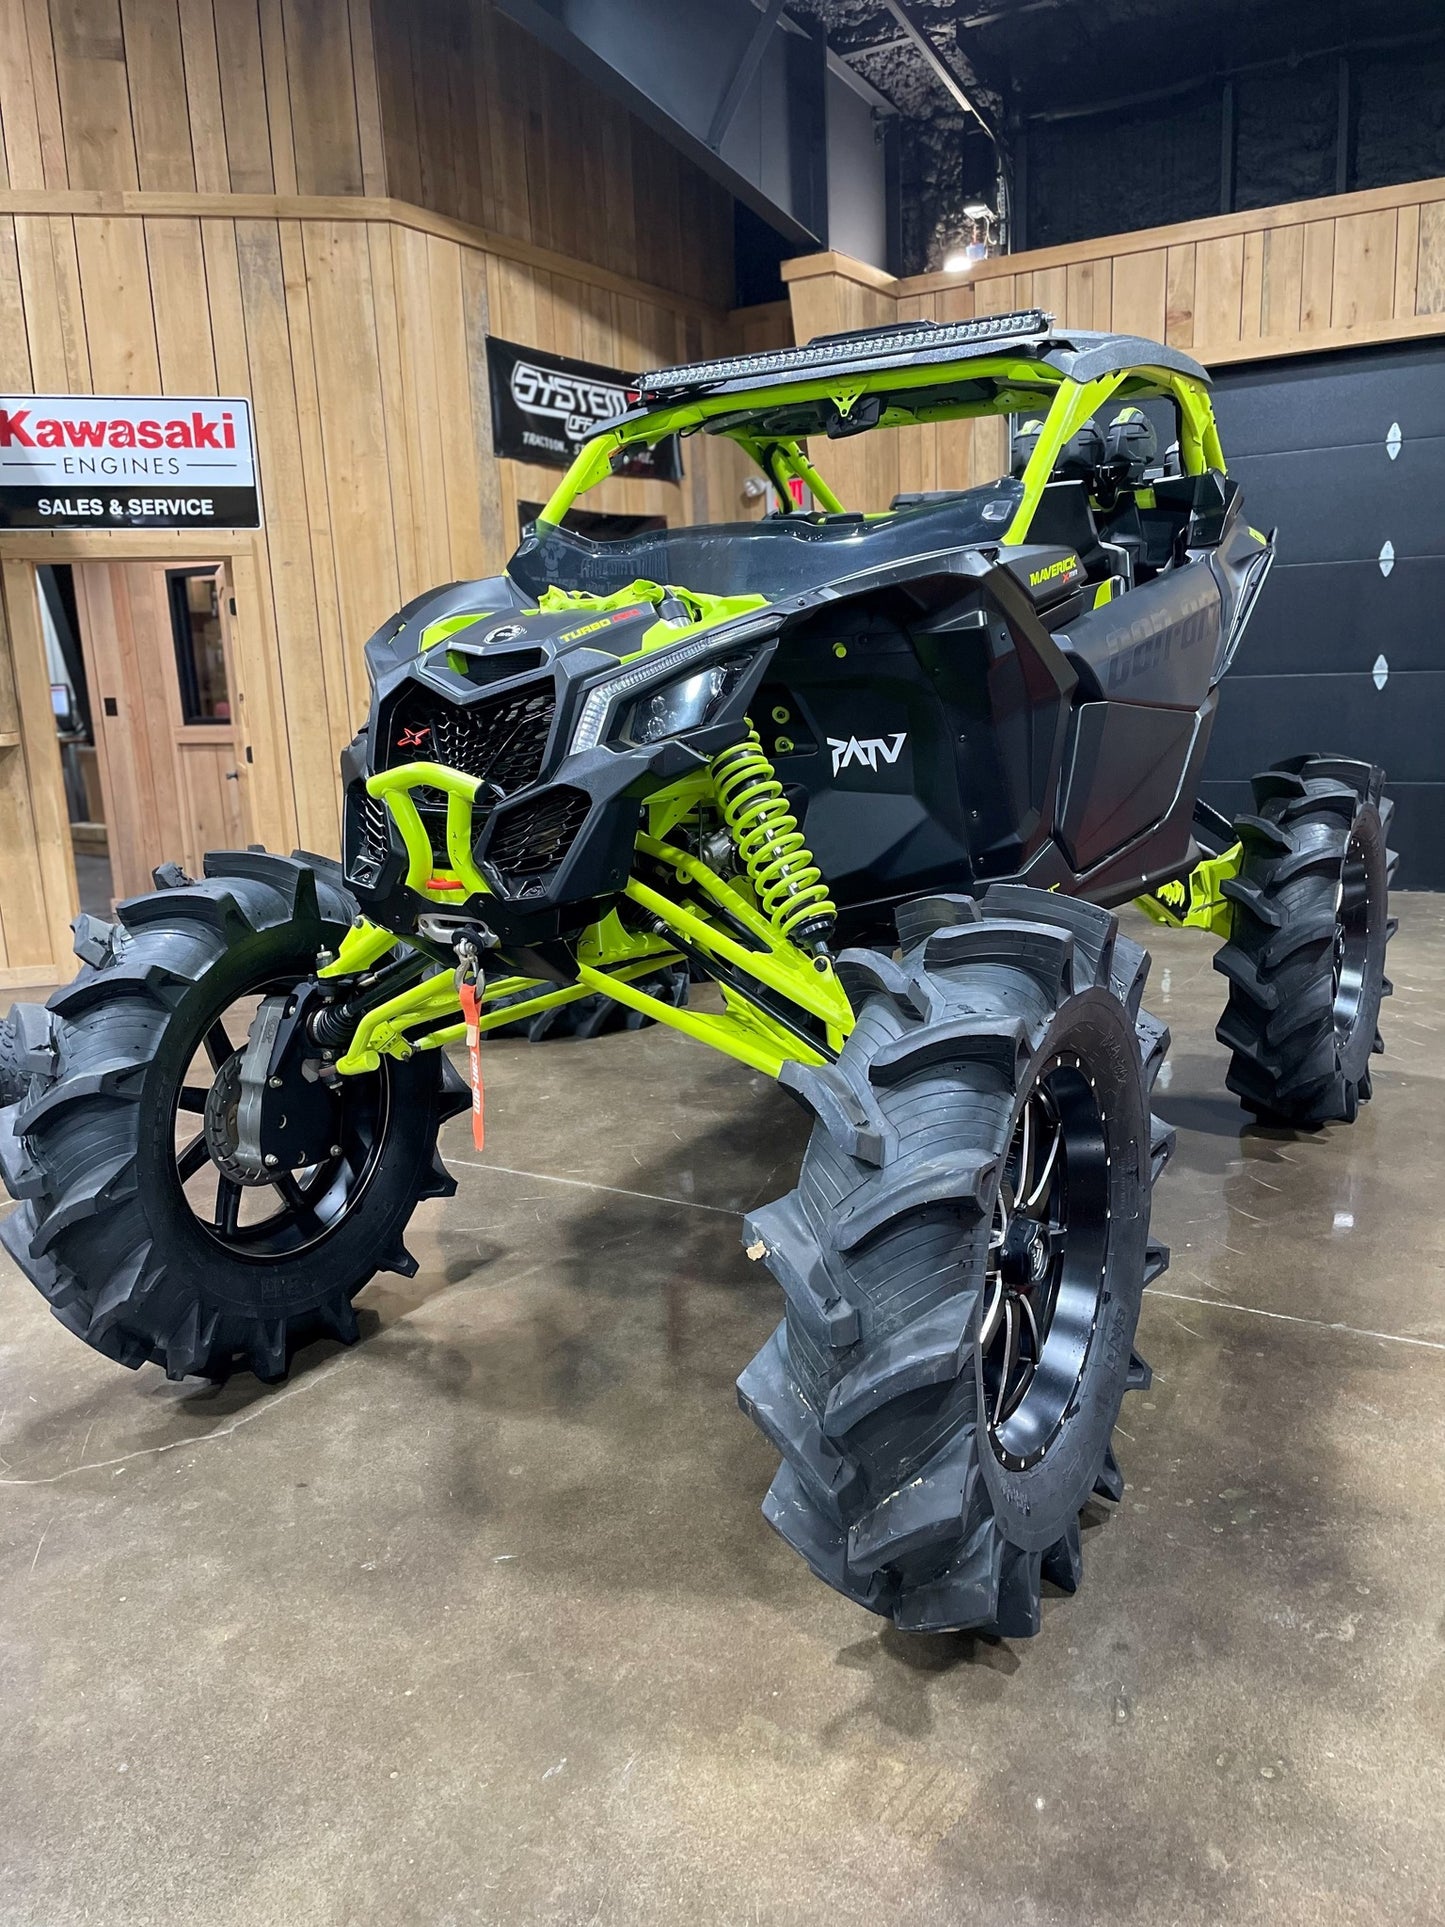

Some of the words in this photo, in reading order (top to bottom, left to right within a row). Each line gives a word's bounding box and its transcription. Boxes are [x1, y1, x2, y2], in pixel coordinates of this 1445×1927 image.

[514, 365, 629, 418] SYSTEM
[0, 409, 236, 449] Kawasaki
[568, 414, 597, 432] OFF
[63, 457, 181, 475] ENGINES
[38, 498, 104, 516] SALES
[109, 499, 124, 515] &
[128, 498, 215, 516] SERVICE
[1029, 555, 1077, 587] MAVERICK
[559, 618, 611, 643] TURBO
